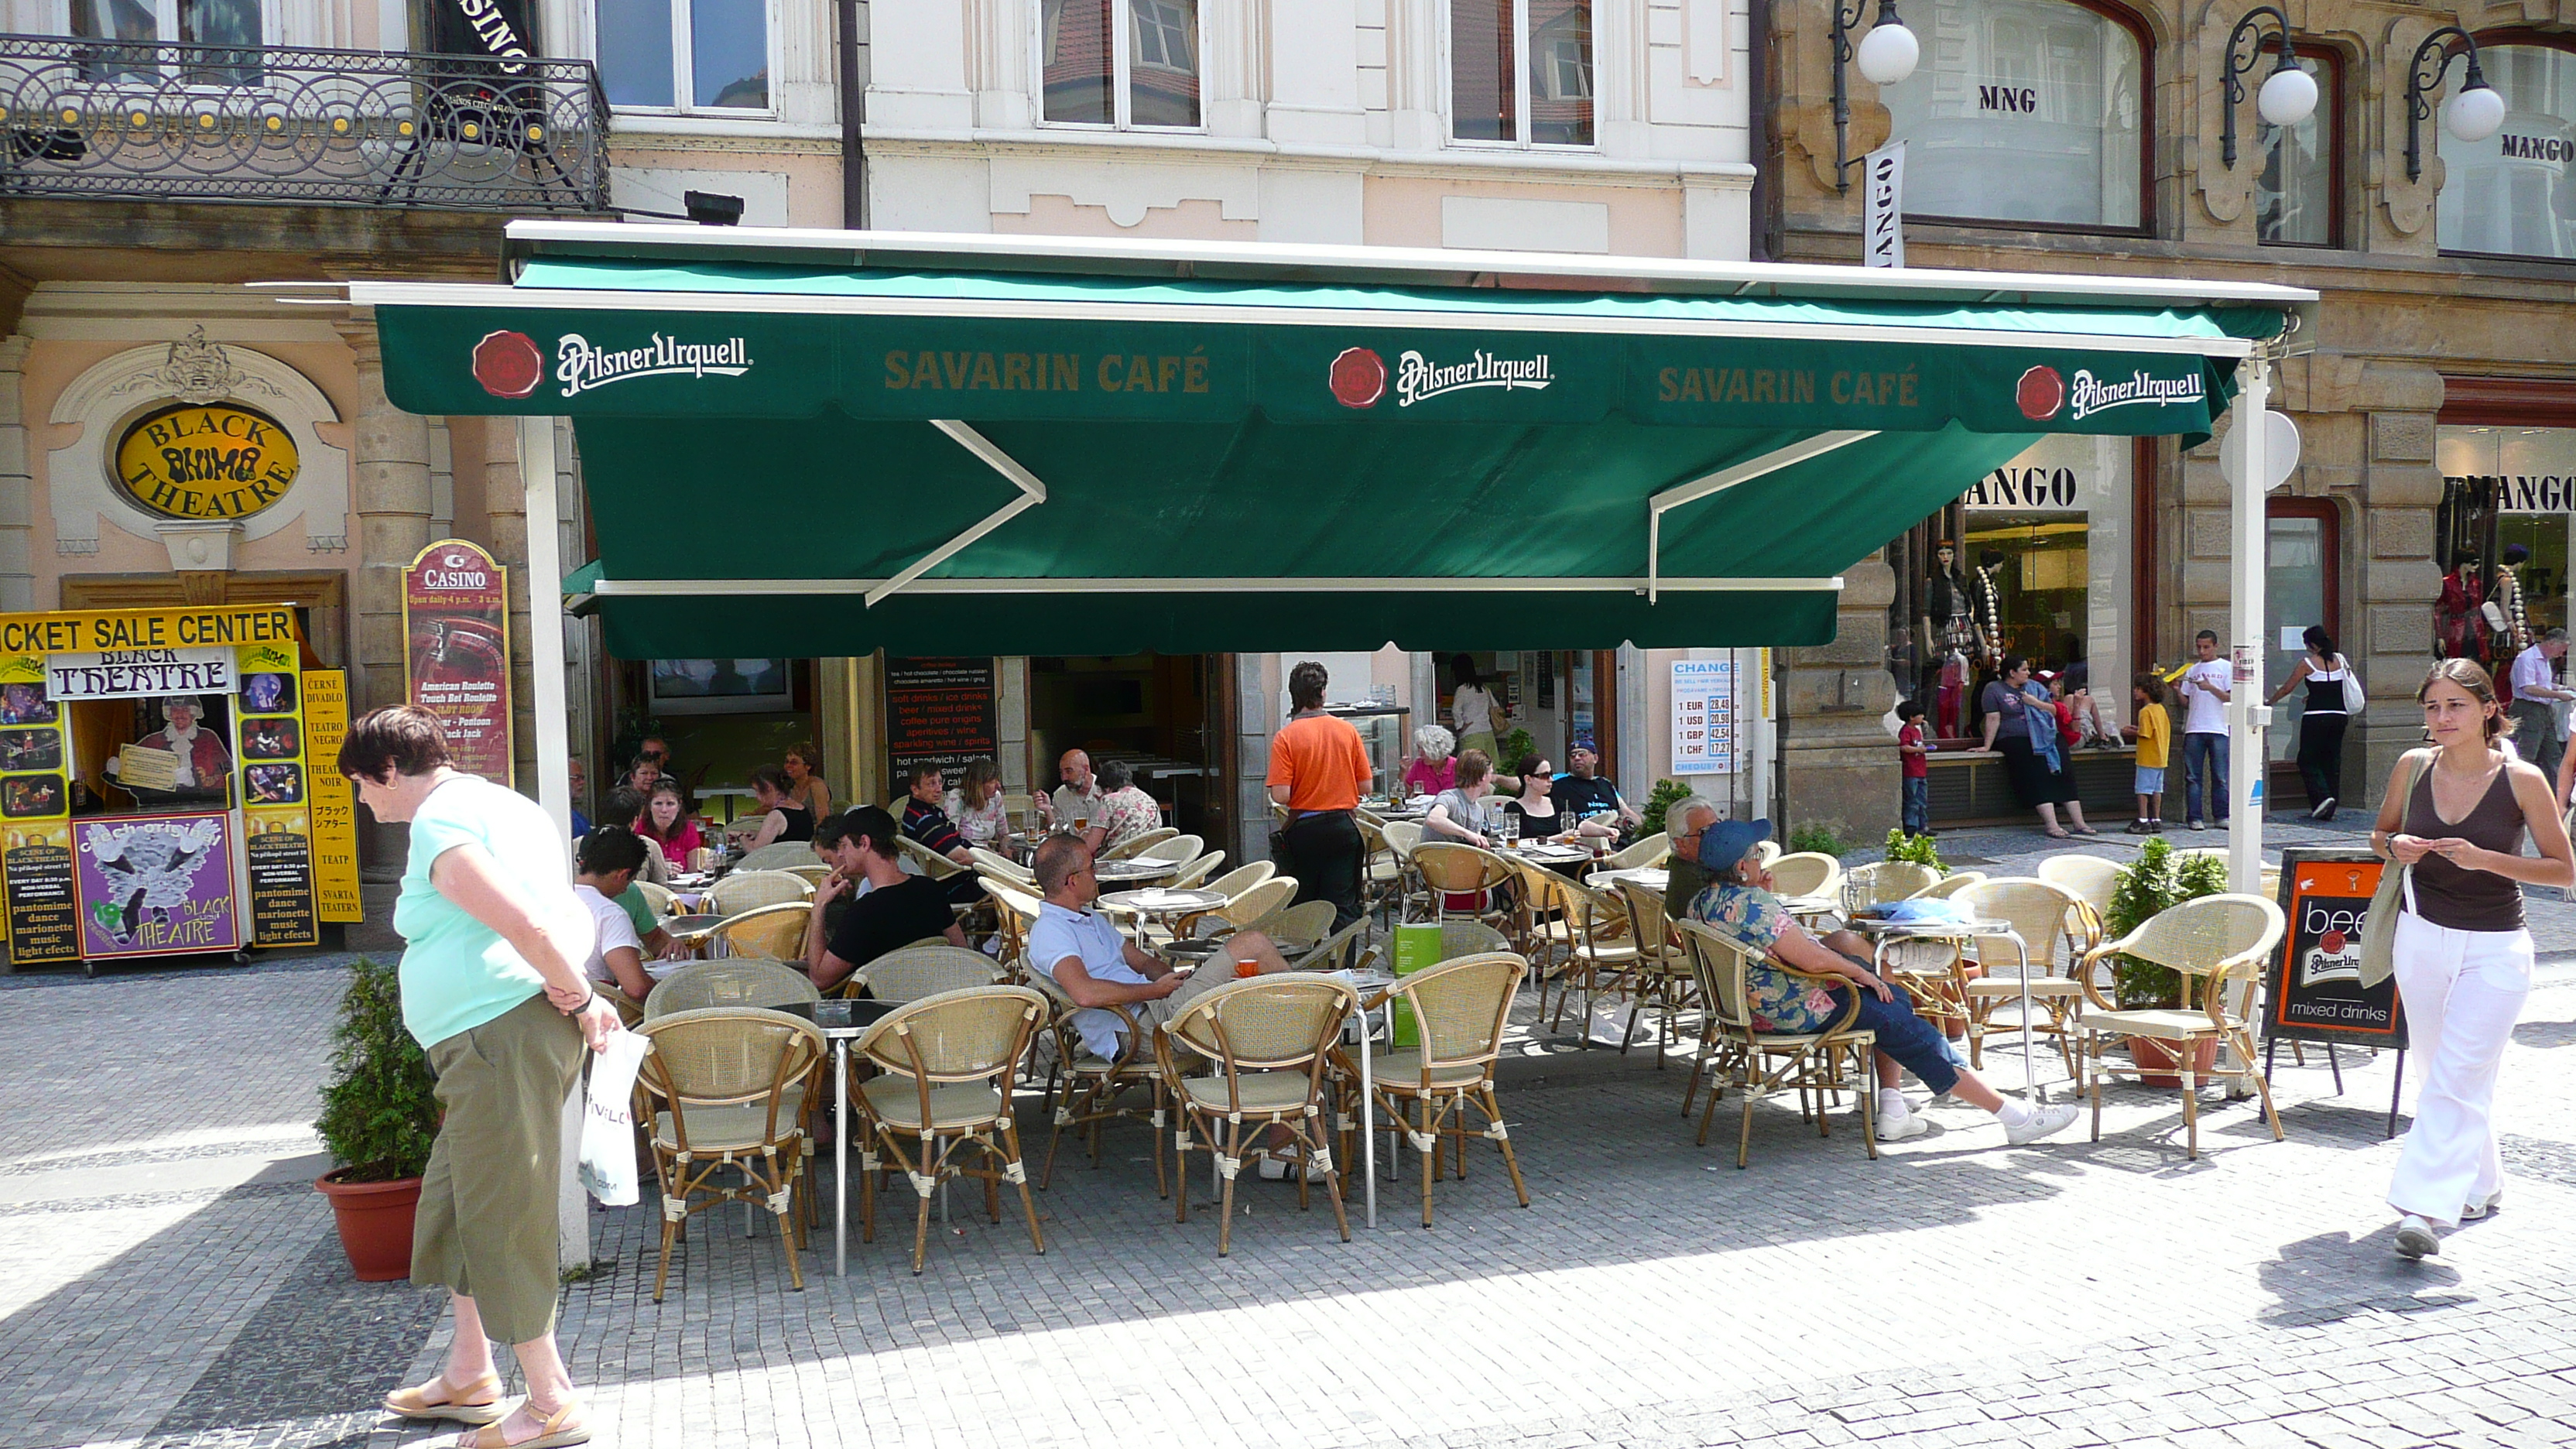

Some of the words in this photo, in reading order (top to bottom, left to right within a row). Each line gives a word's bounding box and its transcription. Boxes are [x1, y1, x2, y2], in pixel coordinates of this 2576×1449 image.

[1979, 85, 2036, 114] MNG
[2502, 134, 2574, 163] MANGO
[1876, 158, 1893, 268] ANGO
[557, 334, 653, 397] Pilsner
[652, 331, 746, 379] Urquell
[885, 350, 1080, 391] SAVARIN
[1097, 345, 1209, 393] CAFÉ
[1396, 350, 1477, 407] Pilsner
[1475, 348, 1549, 392] Urquell
[1659, 367, 1815, 403] SAVARIN
[1830, 362, 1918, 407] CAFÉ
[2071, 369, 2136, 420] Pilsner
[2133, 368, 2201, 408] Urquell
[144, 412, 274, 448] BLACK
[128, 460, 296, 517] THEATRE
[1965, 467, 2077, 506] ANGO
[424, 570, 486, 587] CASINO
[0, 621, 80, 652] CKET
[94, 617, 166, 648] SALE
[177, 611, 291, 644] CENTER
[100, 648, 180, 666] BLACK
[1674, 663, 1740, 673] CHANGE
[53, 662, 228, 695] THEATRE
[308, 677, 337, 690] ČERNÉ
[421, 681, 460, 690] American
[461, 680, 495, 690] Roulette
[307, 693, 343, 703] DIVADLO
[420, 694, 446, 703] Touch
[447, 694, 462, 702] Bet
[464, 693, 497, 702] Roulette
[892, 694, 909, 703] soft
[911, 694, 938, 702] drinks
[946, 692, 959, 701] ice
[961, 691, 988, 701] drinks
[899, 706, 920, 714] beer
[927, 704, 954, 713] mixed
[955, 703, 982, 712] drinks
[900, 717, 927, 725] coffee
[930, 717, 951, 725] pure
[952, 714, 982, 724] origins
[310, 722, 343, 732] TEATRO
[906, 726, 949, 737] aperitives
[957, 726, 978, 735] wine
[463, 728, 481, 738] Jack
[313, 735, 343, 745] NEGRO
[892, 738, 934, 749] sparkling
[936, 738, 957, 746] wine
[964, 736, 991, 746] spirits
[1679, 745, 1683, 754] 1
[1687, 745, 1704, 754] CHF
[310, 764, 341, 774] THEAT
[320, 777, 342, 786] NOIR
[316, 806, 348, 815] ブラック
[315, 818, 348, 828] シアター
[255, 888, 310, 899] pantomime
[323, 889, 354, 899] SVARTA
[12, 902, 73, 913] pantomime
[183, 896, 230, 916] BLACK
[268, 899, 297, 908] dance
[321, 902, 358, 913] TEATERN
[28, 913, 60, 923] dance
[257, 909, 310, 920] marionette
[2304, 900, 2367, 935] bee
[15, 923, 74, 934] marionette
[270, 920, 299, 930] music
[30, 933, 61, 944] music
[135, 920, 216, 949] THEATRE
[259, 931, 282, 942] light
[18, 946, 42, 957] light
[2311, 954, 2345, 975] Pilsner
[2292, 1002, 2337, 1018] mixed
[2341, 1005, 2387, 1022] drinks
